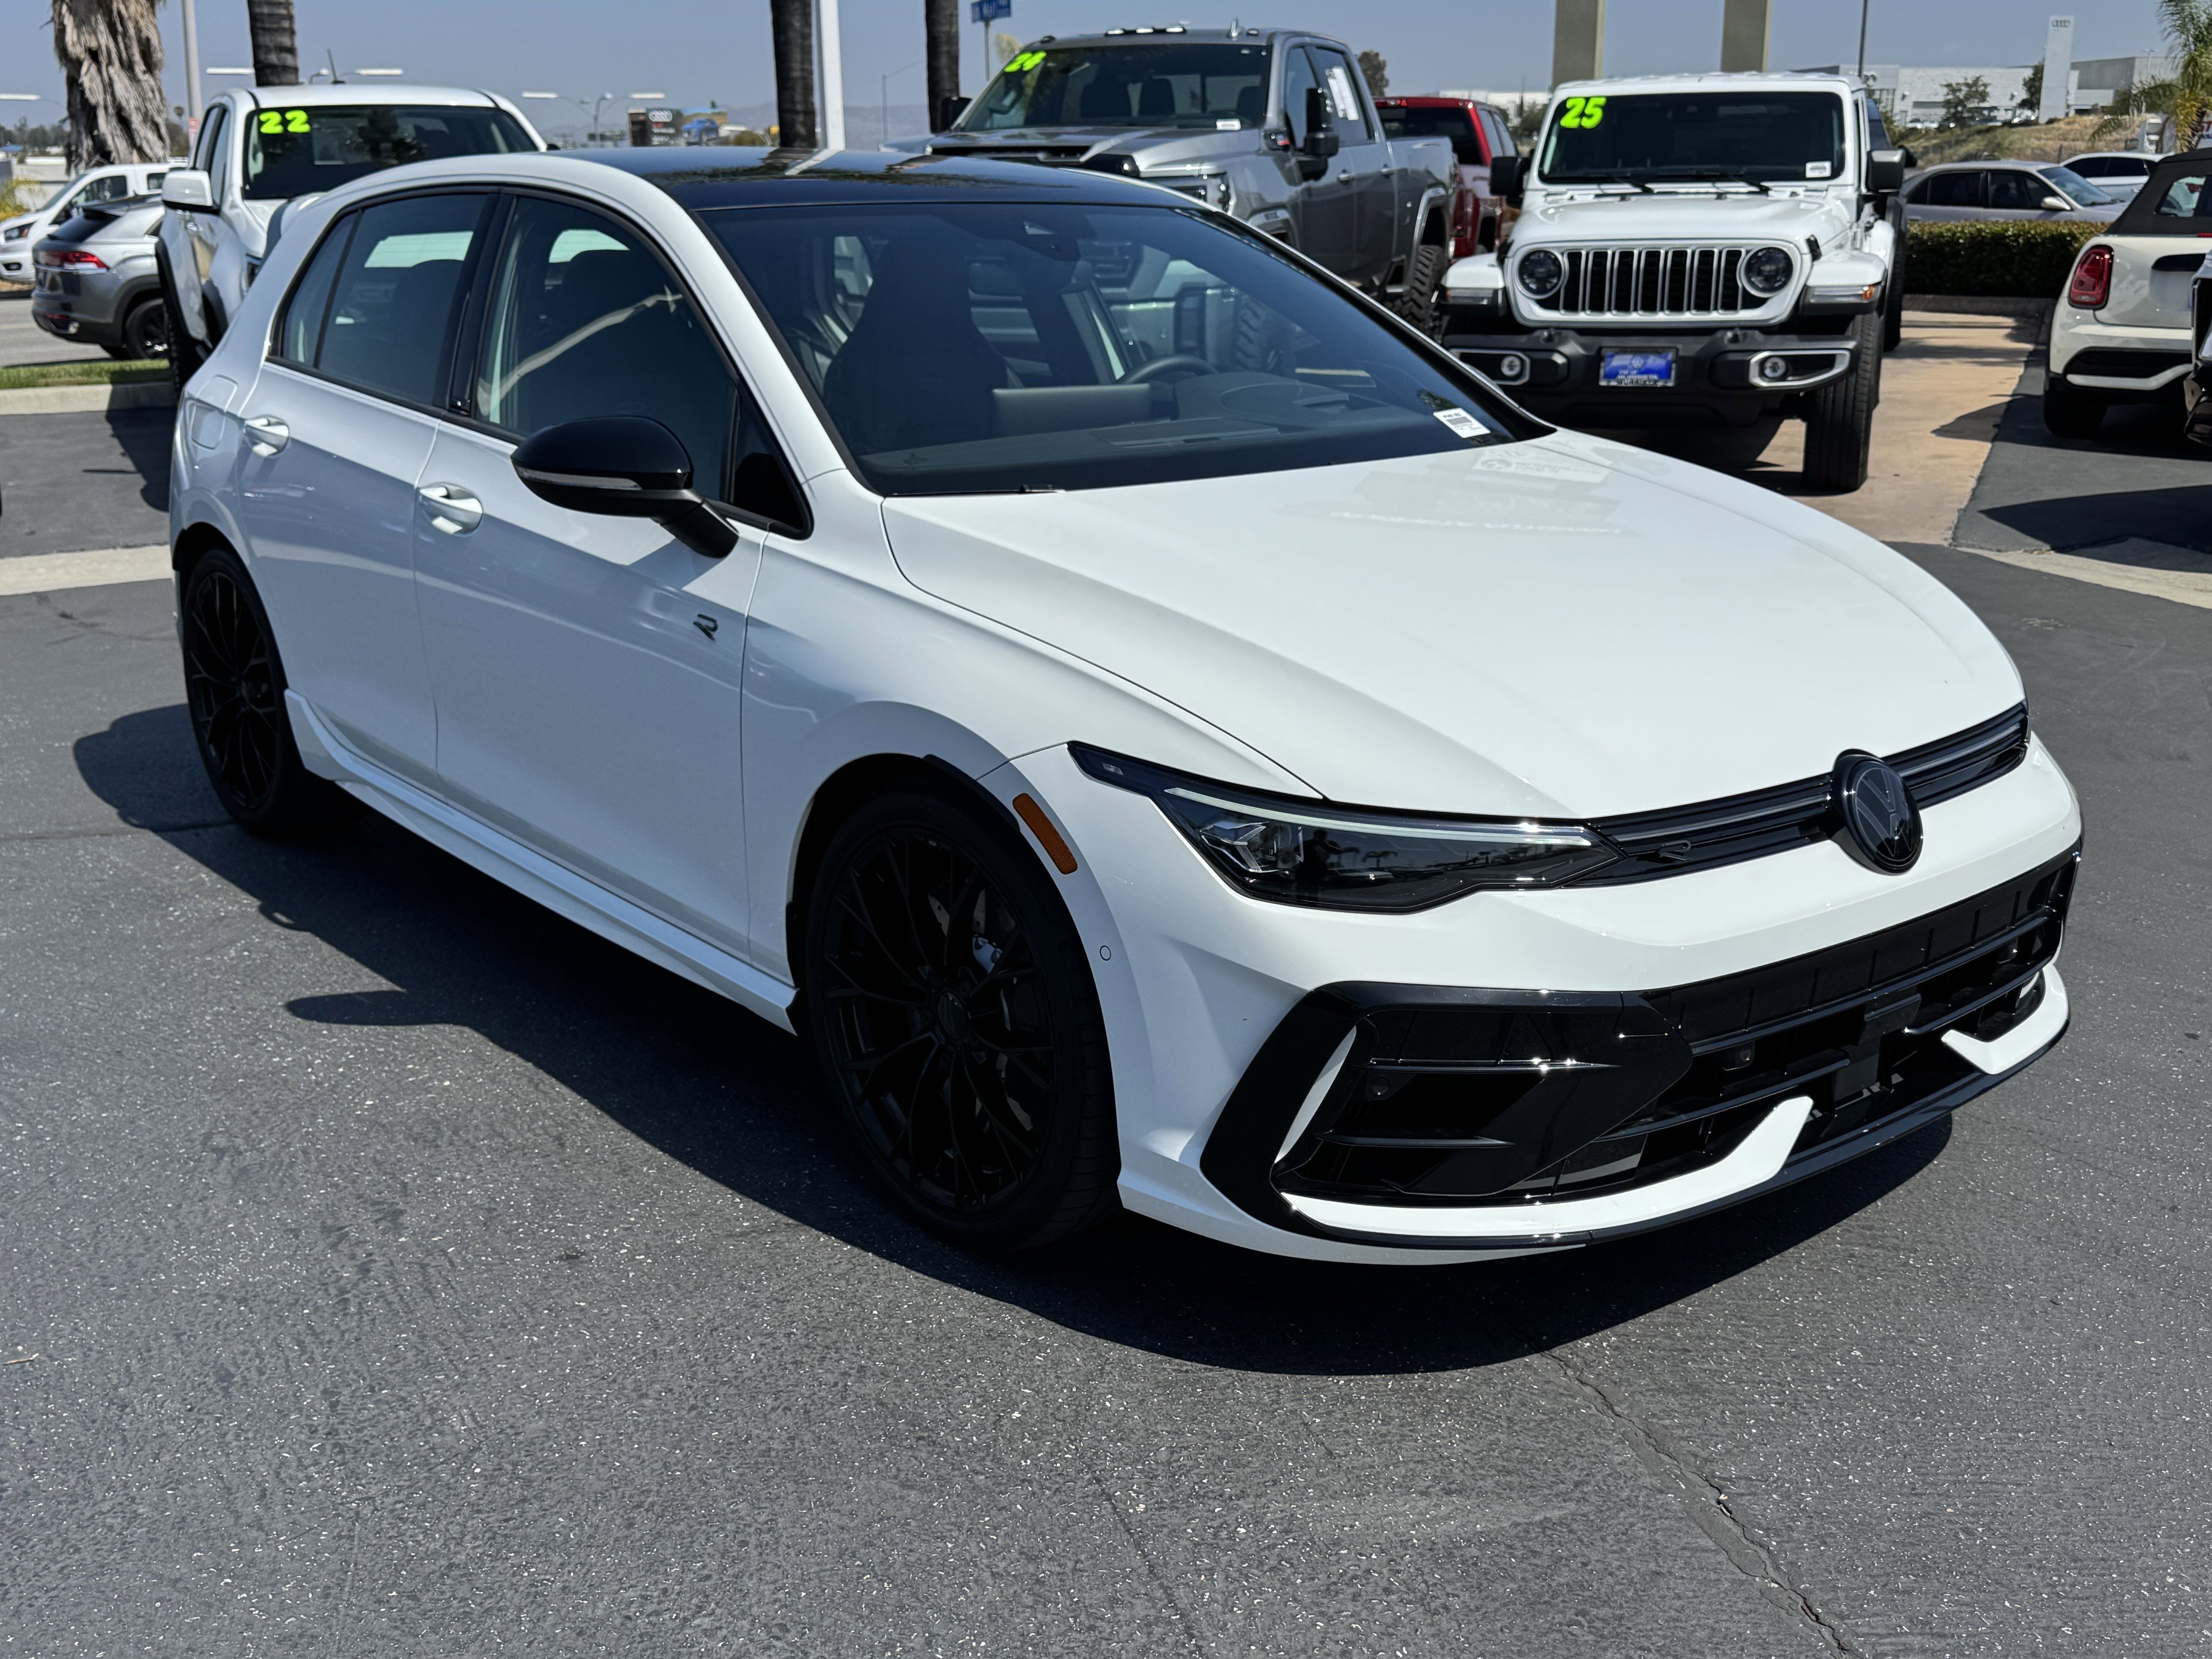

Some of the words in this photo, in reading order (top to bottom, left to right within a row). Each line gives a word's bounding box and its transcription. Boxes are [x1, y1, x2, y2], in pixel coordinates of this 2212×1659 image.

[259, 110, 311, 134] 22
[1560, 96, 1607, 129] 25
[693, 613, 718, 641] R
[1659, 840, 1693, 861] R
